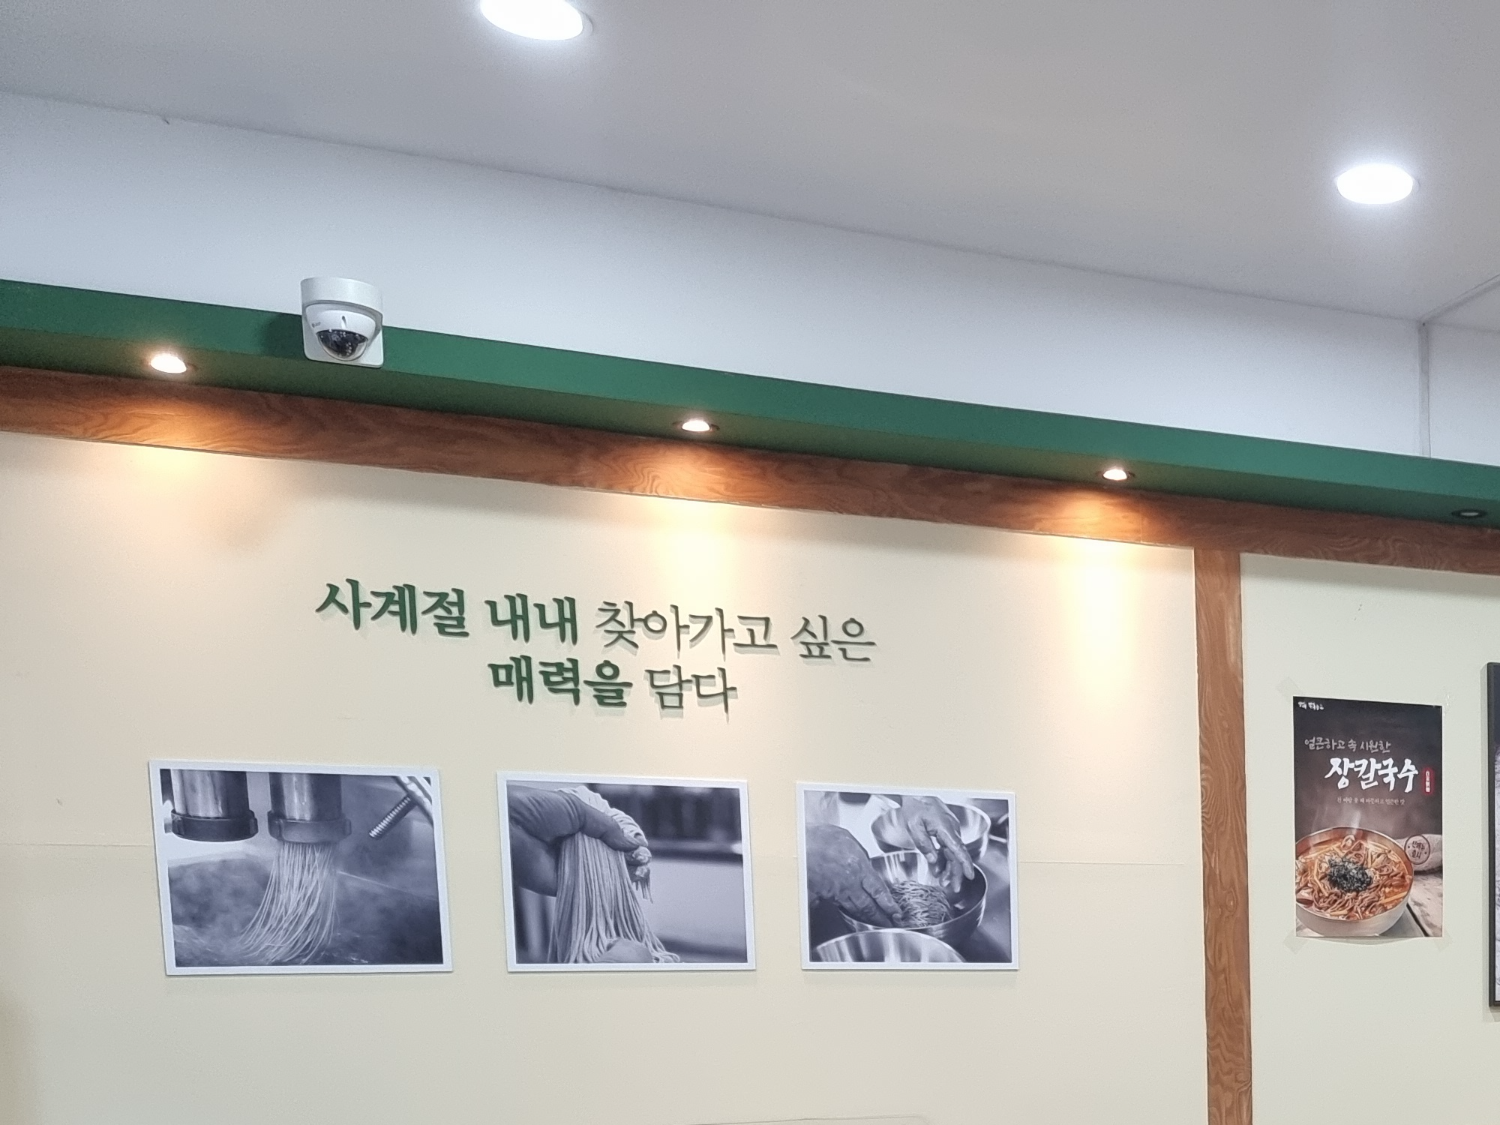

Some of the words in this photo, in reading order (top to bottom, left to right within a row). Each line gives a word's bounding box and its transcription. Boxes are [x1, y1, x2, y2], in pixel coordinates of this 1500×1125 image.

[316, 578, 470, 637] 사계절
[485, 593, 579, 646] 내내
[596, 600, 778, 655] 찾아가고
[791, 615, 876, 662] 싶은
[488, 655, 633, 708] 매력을
[646, 665, 738, 722] 담다
[1305, 736, 1345, 750] 얼큰하고
[1348, 738, 1357, 752] 속
[1360, 740, 1391, 753] 시원한
[1324, 757, 1419, 793] 장칼국수
